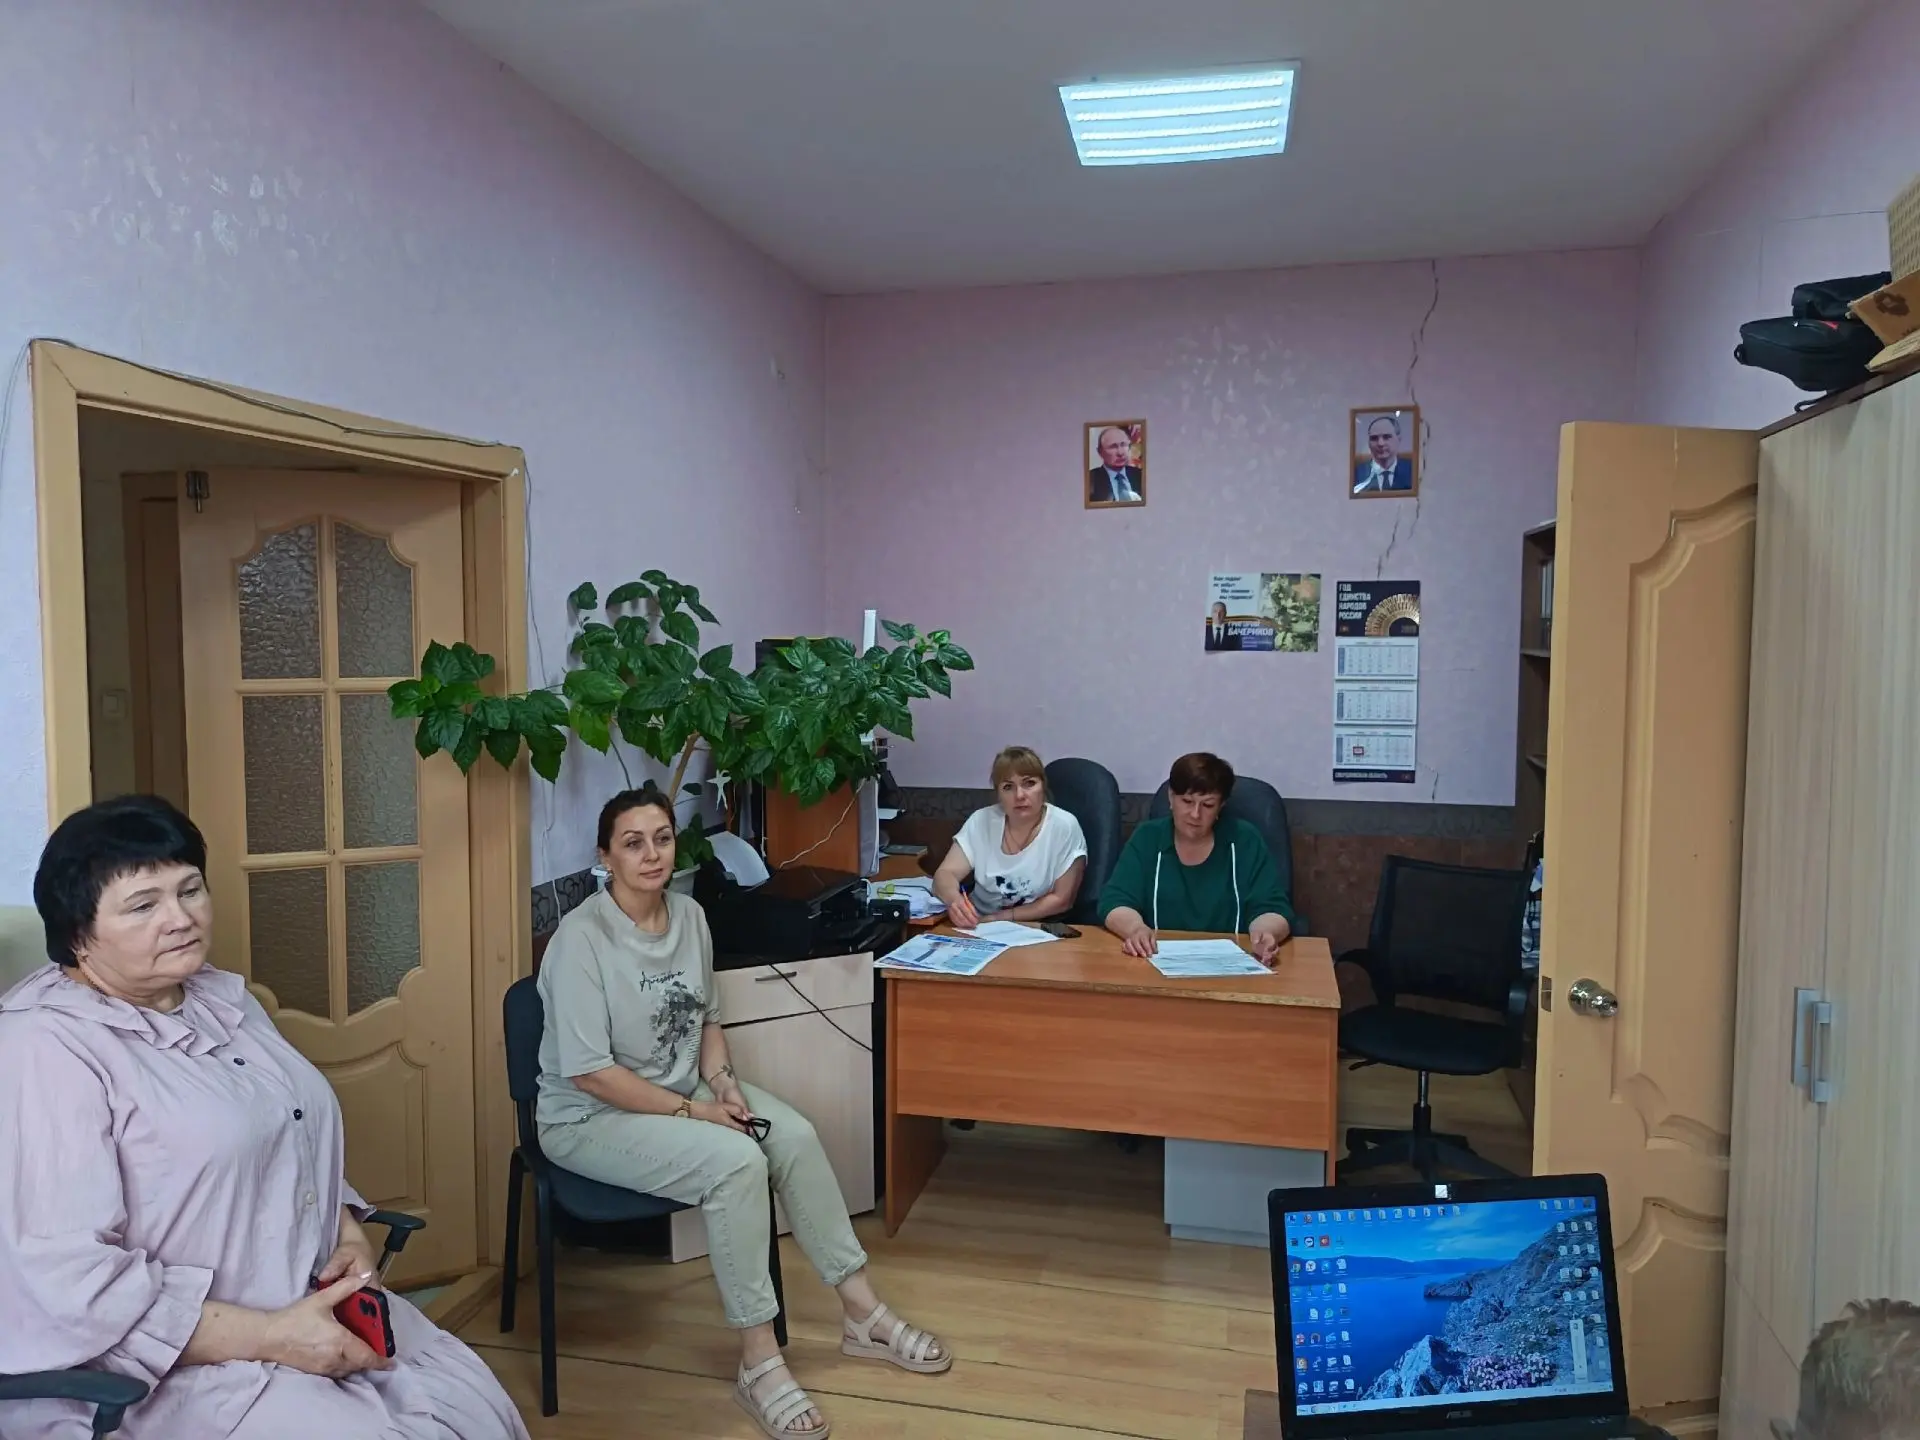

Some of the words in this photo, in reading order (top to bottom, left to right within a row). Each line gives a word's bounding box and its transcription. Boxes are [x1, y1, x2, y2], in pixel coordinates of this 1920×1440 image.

[1339, 584, 1352, 592] ГОД
[1339, 593, 1371, 601] ЕДИНСТВА
[1338, 602, 1367, 610] НАРОДОВ
[1338, 612, 1362, 620] РОССИИ
